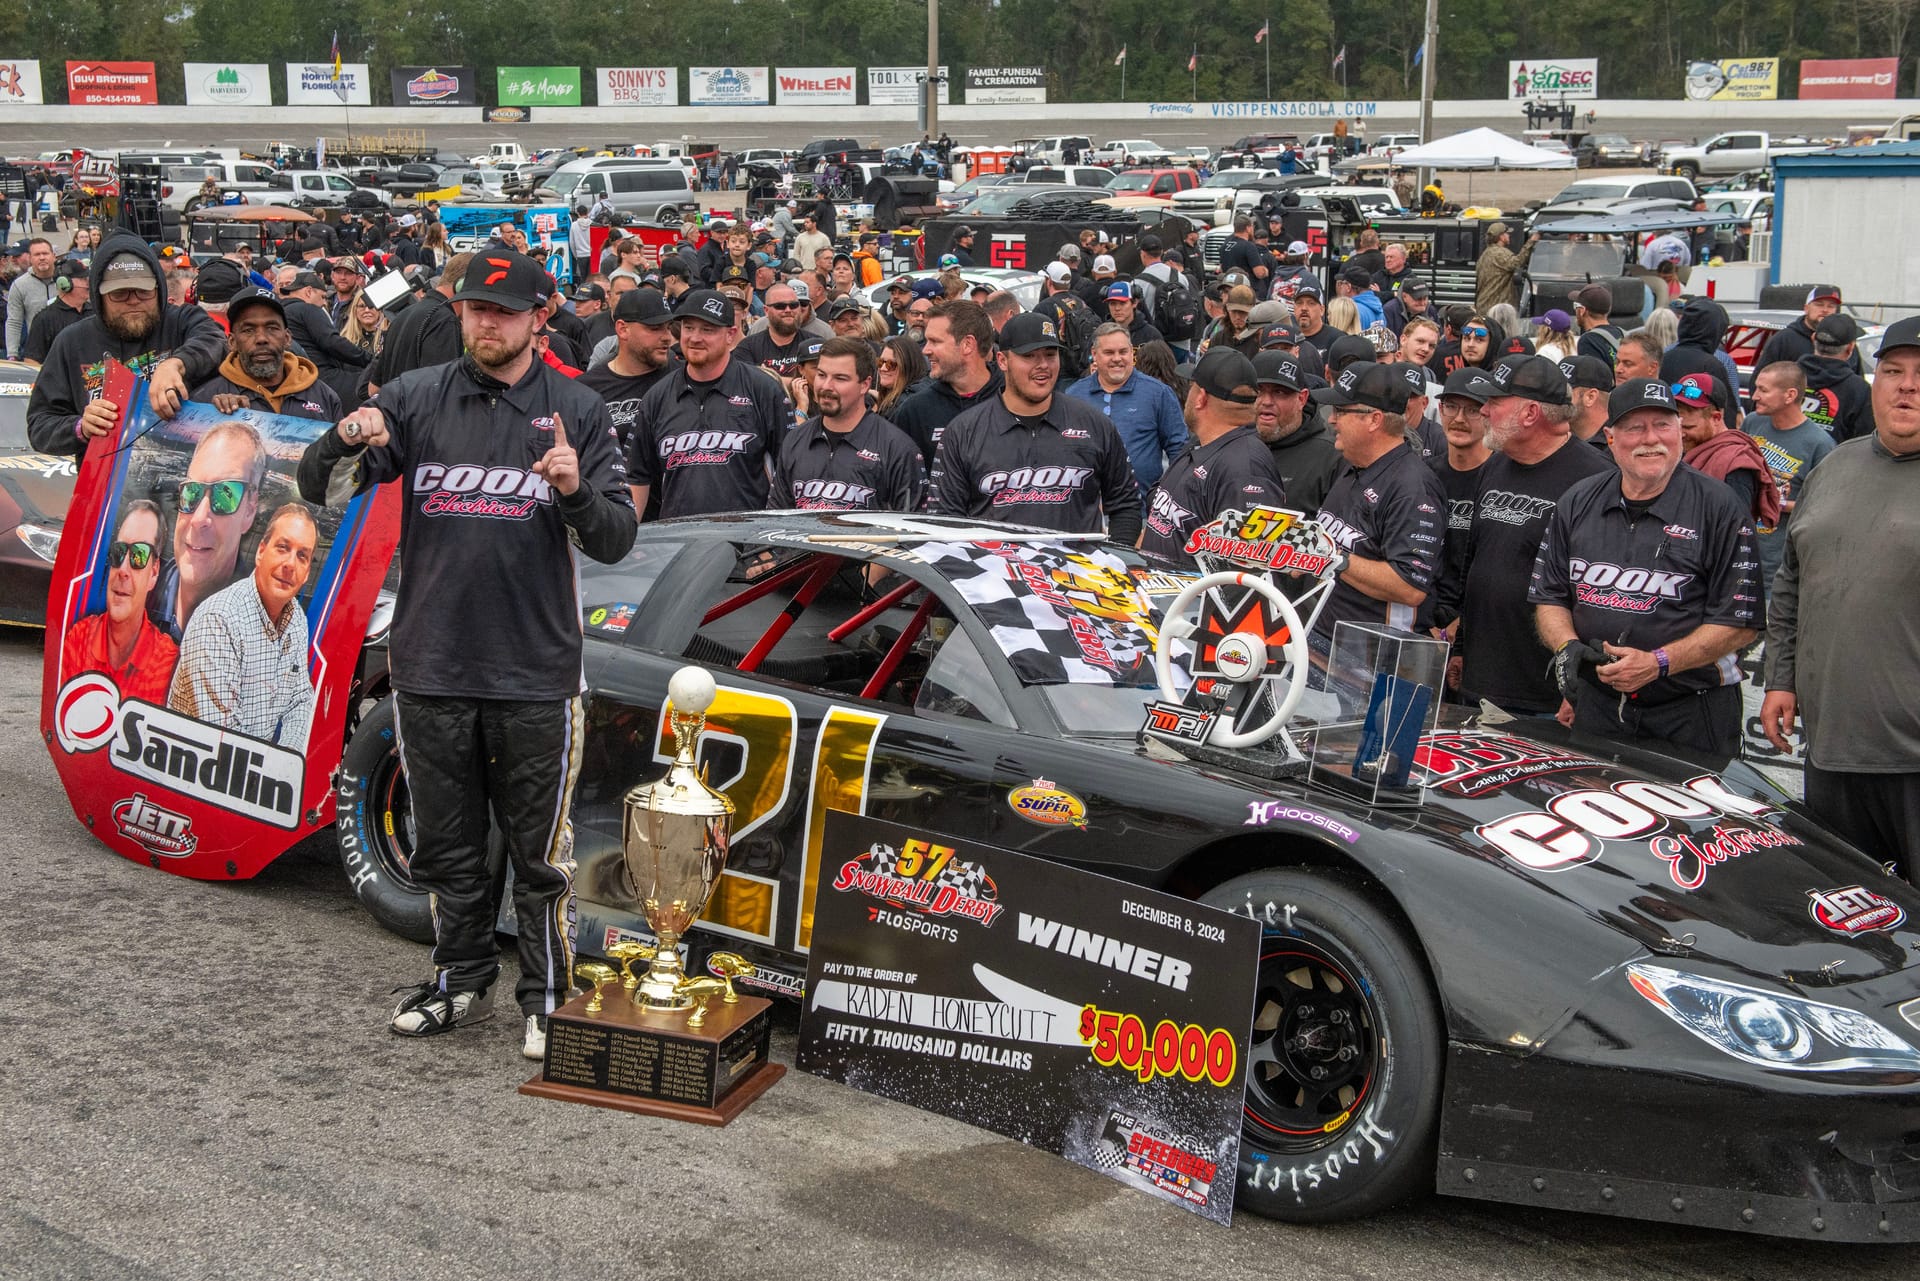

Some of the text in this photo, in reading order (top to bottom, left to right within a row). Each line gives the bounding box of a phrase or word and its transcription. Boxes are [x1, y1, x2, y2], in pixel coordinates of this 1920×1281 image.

[74, 75, 149, 84] GUY BROTHERS
[301, 73, 354, 81] NORTHEST
[608, 70, 666, 88] SONNY'S
[870, 72, 899, 84] TOOL
[968, 67, 1043, 77] FAMILY-FUNERAL
[1749, 61, 1774, 72] 98.7
[1801, 76, 1873, 85] GENERAL TIRE
[302, 82, 356, 90] FLORIDA A/C
[613, 88, 640, 101] BBQ
[779, 75, 851, 91] WHELEN
[974, 76, 1037, 86] & CREMATION
[1728, 84, 1771, 92] HOMETOWN
[1149, 103, 1194, 115] Pensacola
[1211, 102, 1377, 117] VISITPENSACOLA.COM
[77, 153, 114, 176] JETT
[113, 261, 144, 270] Columbia
[1644, 383, 1667, 399] 21
[659, 430, 757, 457] COOK
[666, 450, 735, 469] Electrical
[413, 463, 552, 503] COOK
[794, 479, 879, 503] COOK
[980, 466, 1094, 497] COOK
[423, 492, 537, 521] Electrical
[993, 488, 1071, 507] Electrical
[1480, 490, 1555, 518] COOK
[1238, 508, 1299, 543] 57
[1316, 509, 1369, 552] OOK
[1184, 527, 1334, 576] SNOWBALL DERBY
[1569, 557, 1696, 600] COOK
[1576, 584, 1660, 613] Electrical
[116, 710, 294, 816] Sandlin
[120, 795, 191, 837] JETT
[1017, 797, 1070, 813] SUPER
[338, 768, 377, 894] Hoosier
[1273, 807, 1354, 840] HOOSIER
[1475, 774, 1786, 872] COOK
[124, 825, 182, 850] MOTORSPORTS
[895, 838, 955, 882] 57
[1649, 823, 1805, 890] Electrical
[833, 861, 1004, 928] SNOWBALL DERBY
[1810, 887, 1878, 923] JETT
[876, 910, 959, 943] FLOSPORTS
[1122, 899, 1226, 944] DECEMBER 8, 2024
[1843, 906, 1898, 931] MOTORSPORTS
[1018, 911, 1192, 992] WINNER
[823, 961, 918, 985] PAY TO THE ORDER OF
[847, 983, 1057, 1043] KADEN HONEYCUTT
[825, 1023, 1033, 1072] FIFTY THOUSAND DOLLARS
[1078, 1003, 1236, 1087] $50,000
[1110, 1112, 1168, 1141] FIVE FLAGS
[1127, 1131, 1217, 1185] SPEEDWAY
[1247, 1101, 1396, 1206] Hoosier
